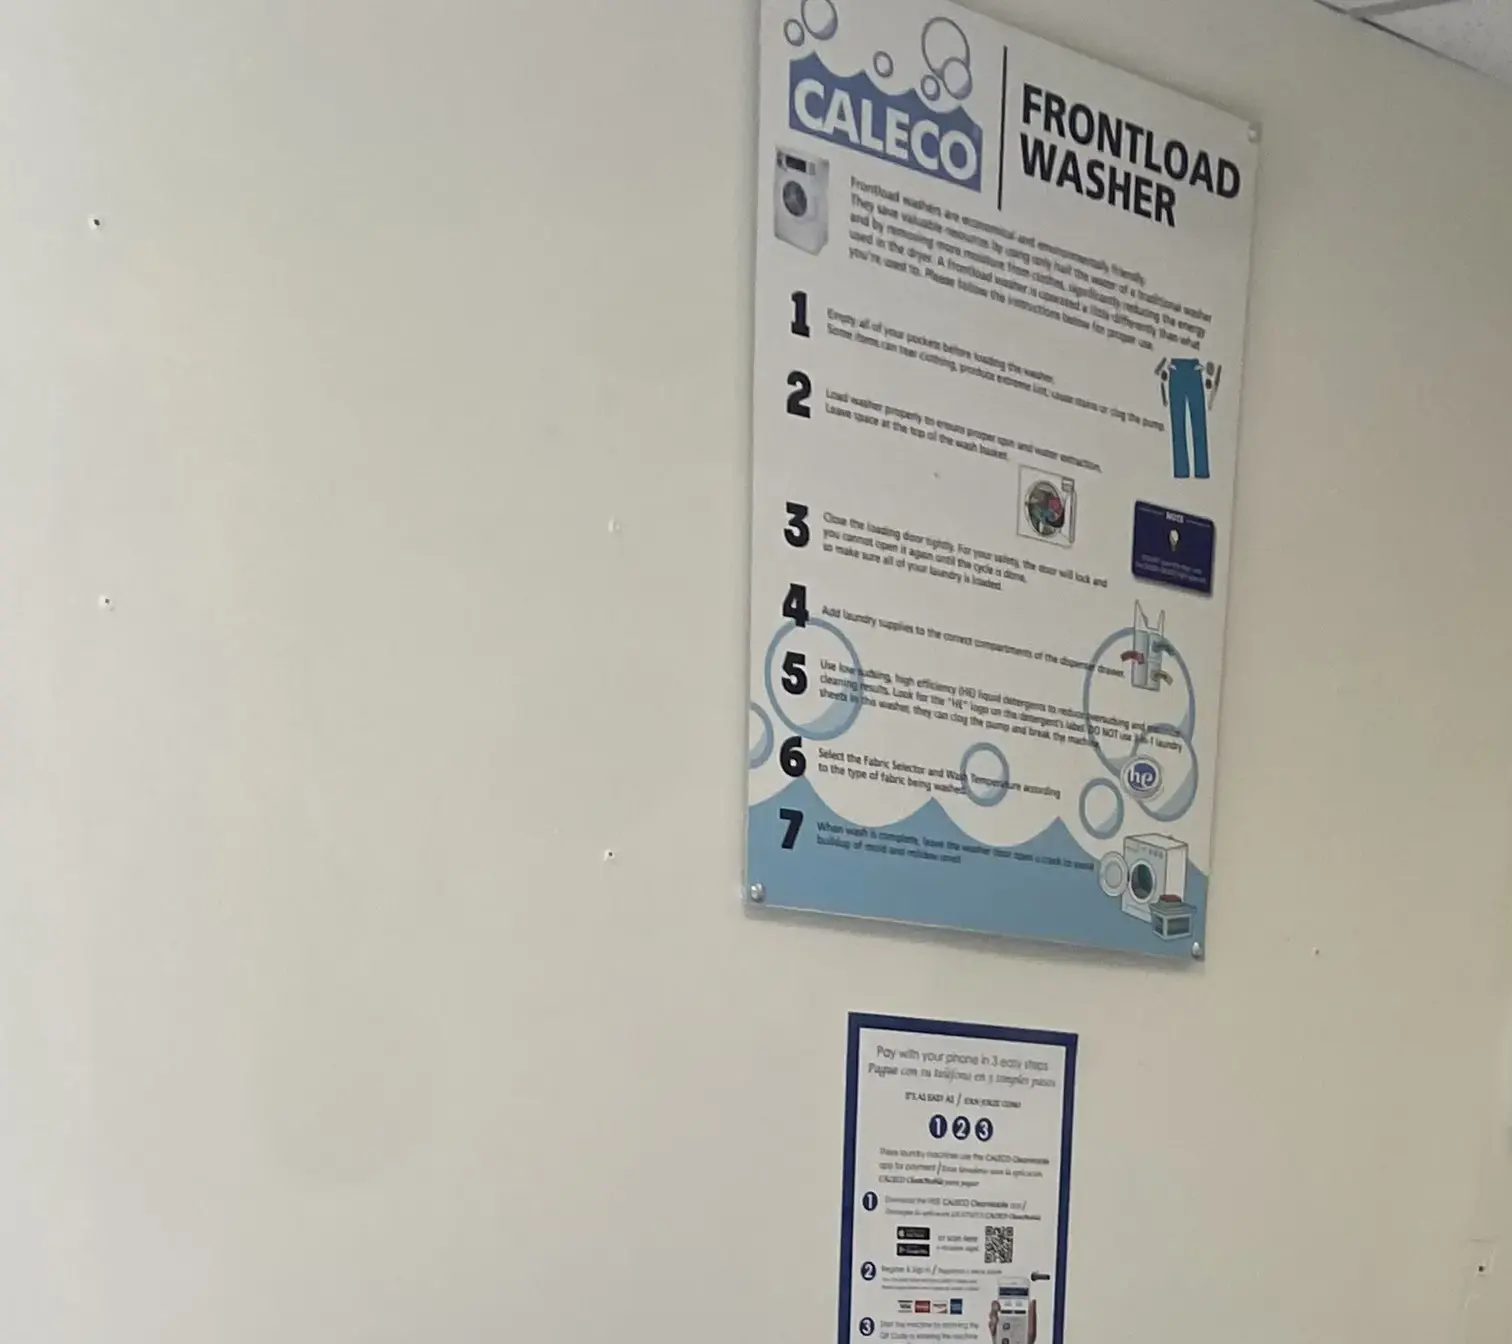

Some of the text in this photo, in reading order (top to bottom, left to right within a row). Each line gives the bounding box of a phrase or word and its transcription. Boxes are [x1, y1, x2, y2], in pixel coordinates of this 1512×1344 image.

[793, 78, 979, 182] CALECO
[1021, 82, 1242, 199] FRONTLOAD
[1020, 133, 1177, 228] WASHER
[792, 291, 810, 338] 1
[787, 370, 811, 418] 2
[784, 501, 810, 548] 3
[783, 583, 809, 628] 4
[820, 604, 841, 619] Add
[842, 609, 876, 628] laundry
[782, 651, 807, 695] 5
[819, 659, 836, 670] Use
[779, 736, 807, 778] 6
[817, 761, 931, 792] to the type of fabric being
[818, 747, 1061, 800] Select the Fabric Selector and Wash Temperature according
[779, 808, 803, 850] 7
[876, 1046, 895, 1059] Pay
[899, 1047, 919, 1059] with
[921, 1052, 943, 1063] your
[945, 1051, 979, 1066] phone
[980, 1054, 989, 1065] in
[990, 1055, 998, 1066] 3
[999, 1058, 1021, 1070] easy
[934, 1118, 988, 1138] 1 2 3
[865, 1193, 874, 1209] 1
[863, 1263, 873, 1278] 2
[861, 1319, 872, 1334] 3
